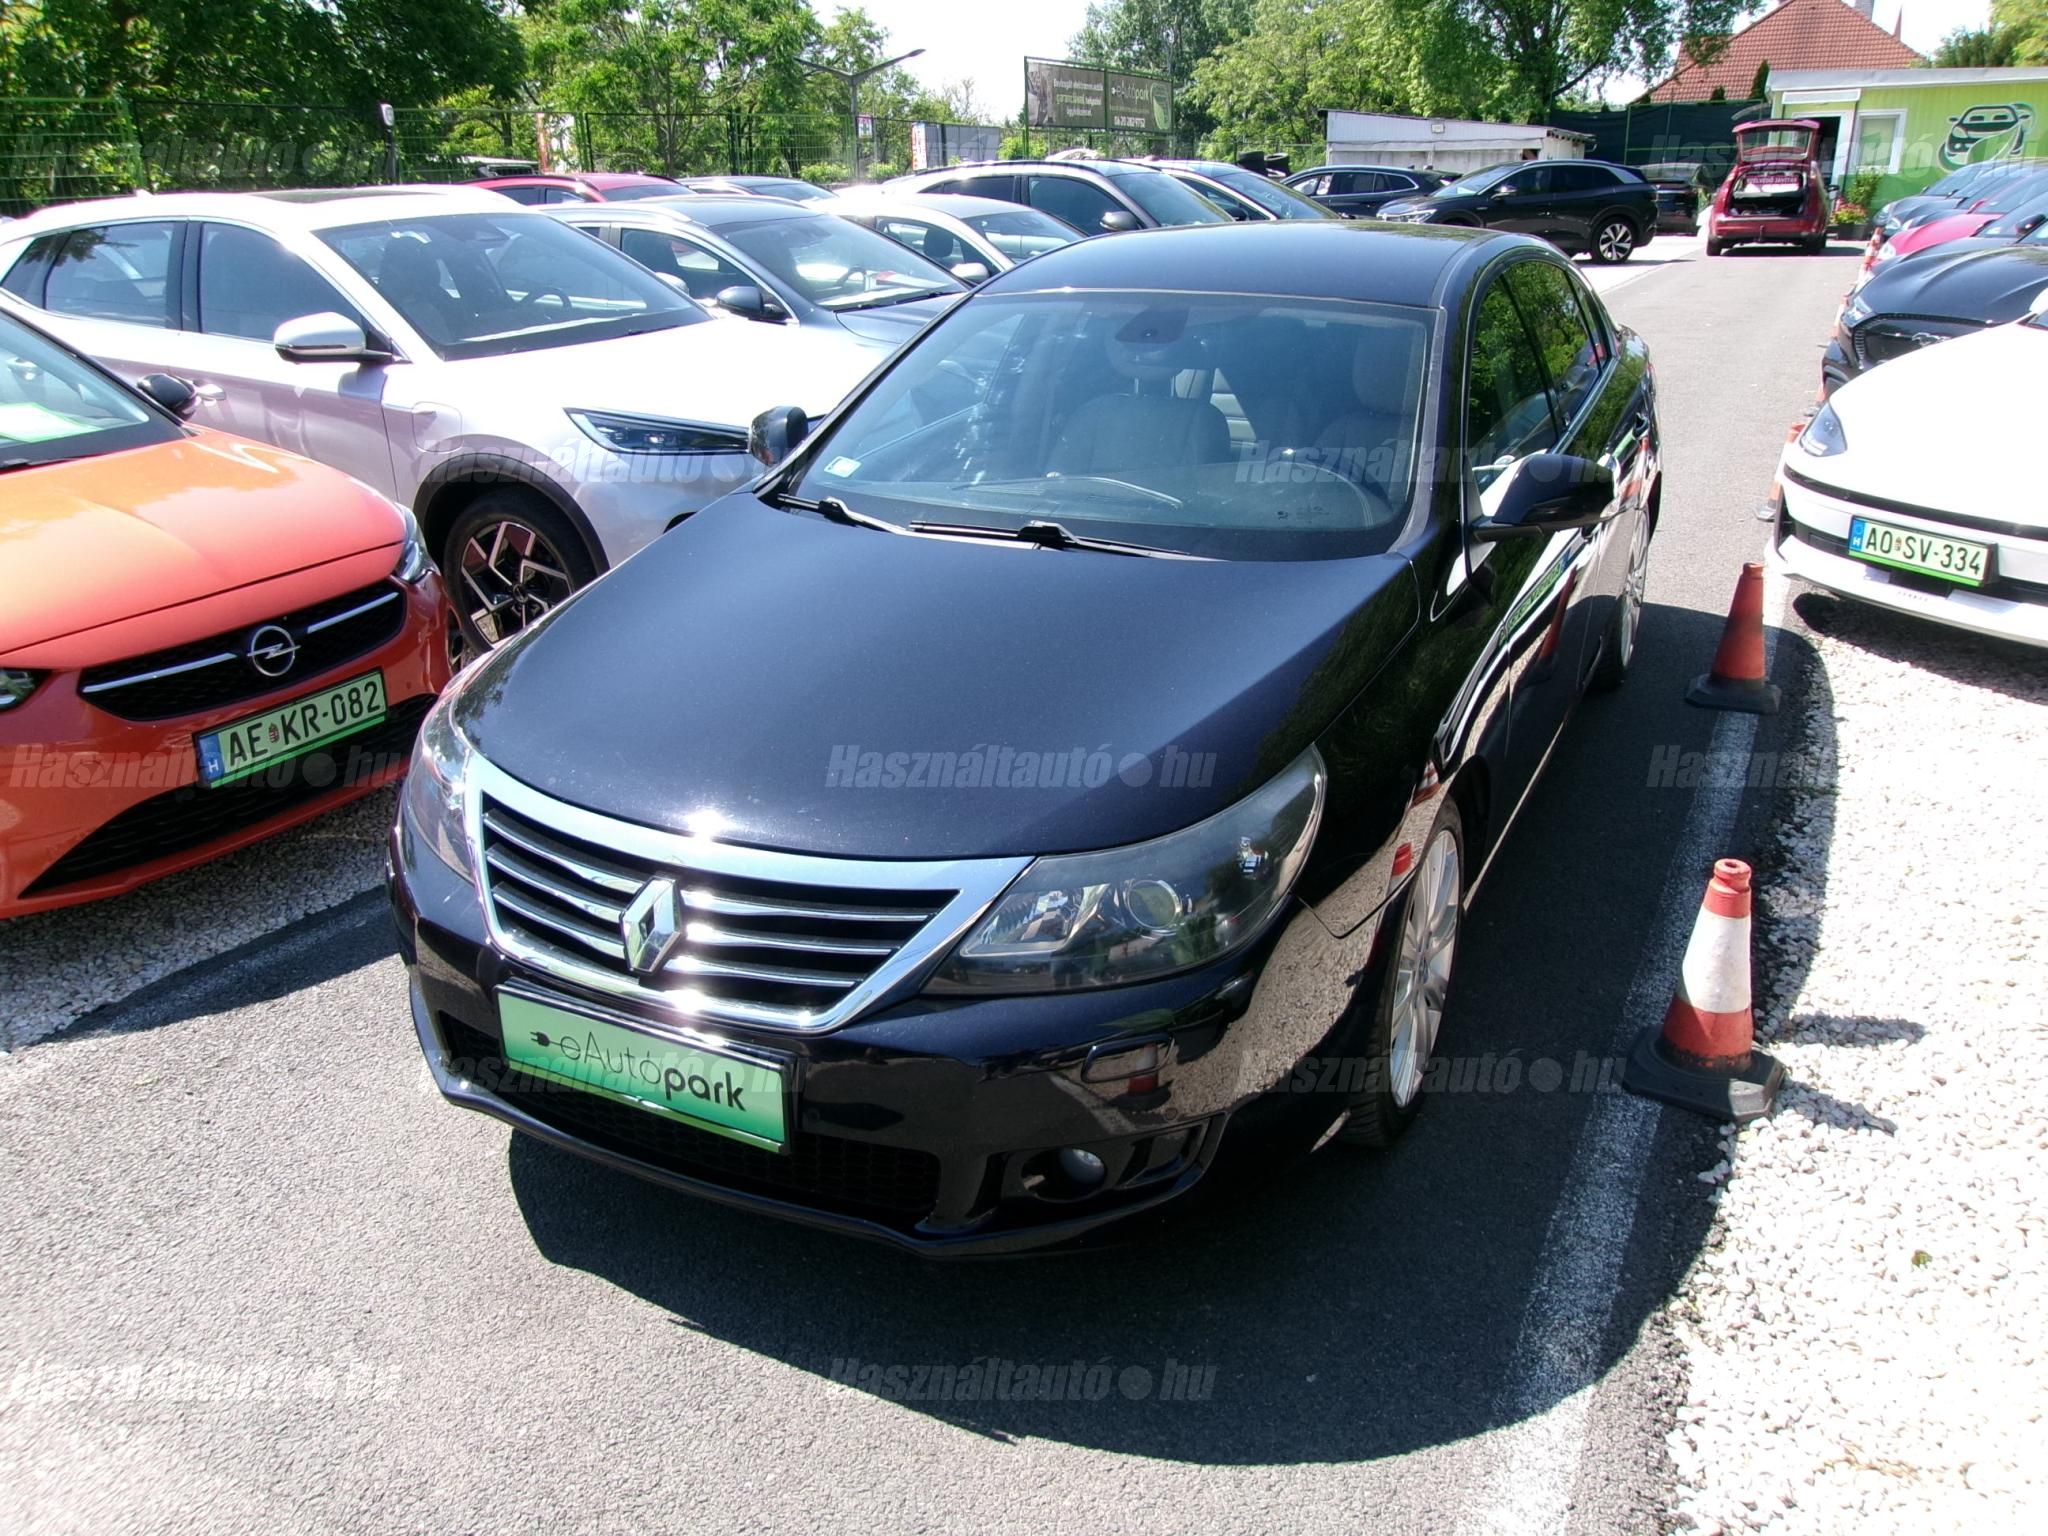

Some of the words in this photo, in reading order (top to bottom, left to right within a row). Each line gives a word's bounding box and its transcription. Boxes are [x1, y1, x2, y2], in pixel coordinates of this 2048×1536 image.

[1866, 527, 1893, 554] AO
[1903, 536, 1981, 575] SV-334
[229, 722, 268, 766] AE
[281, 681, 381, 745] KR-082
[560, 1031, 747, 1112] eAutópark
